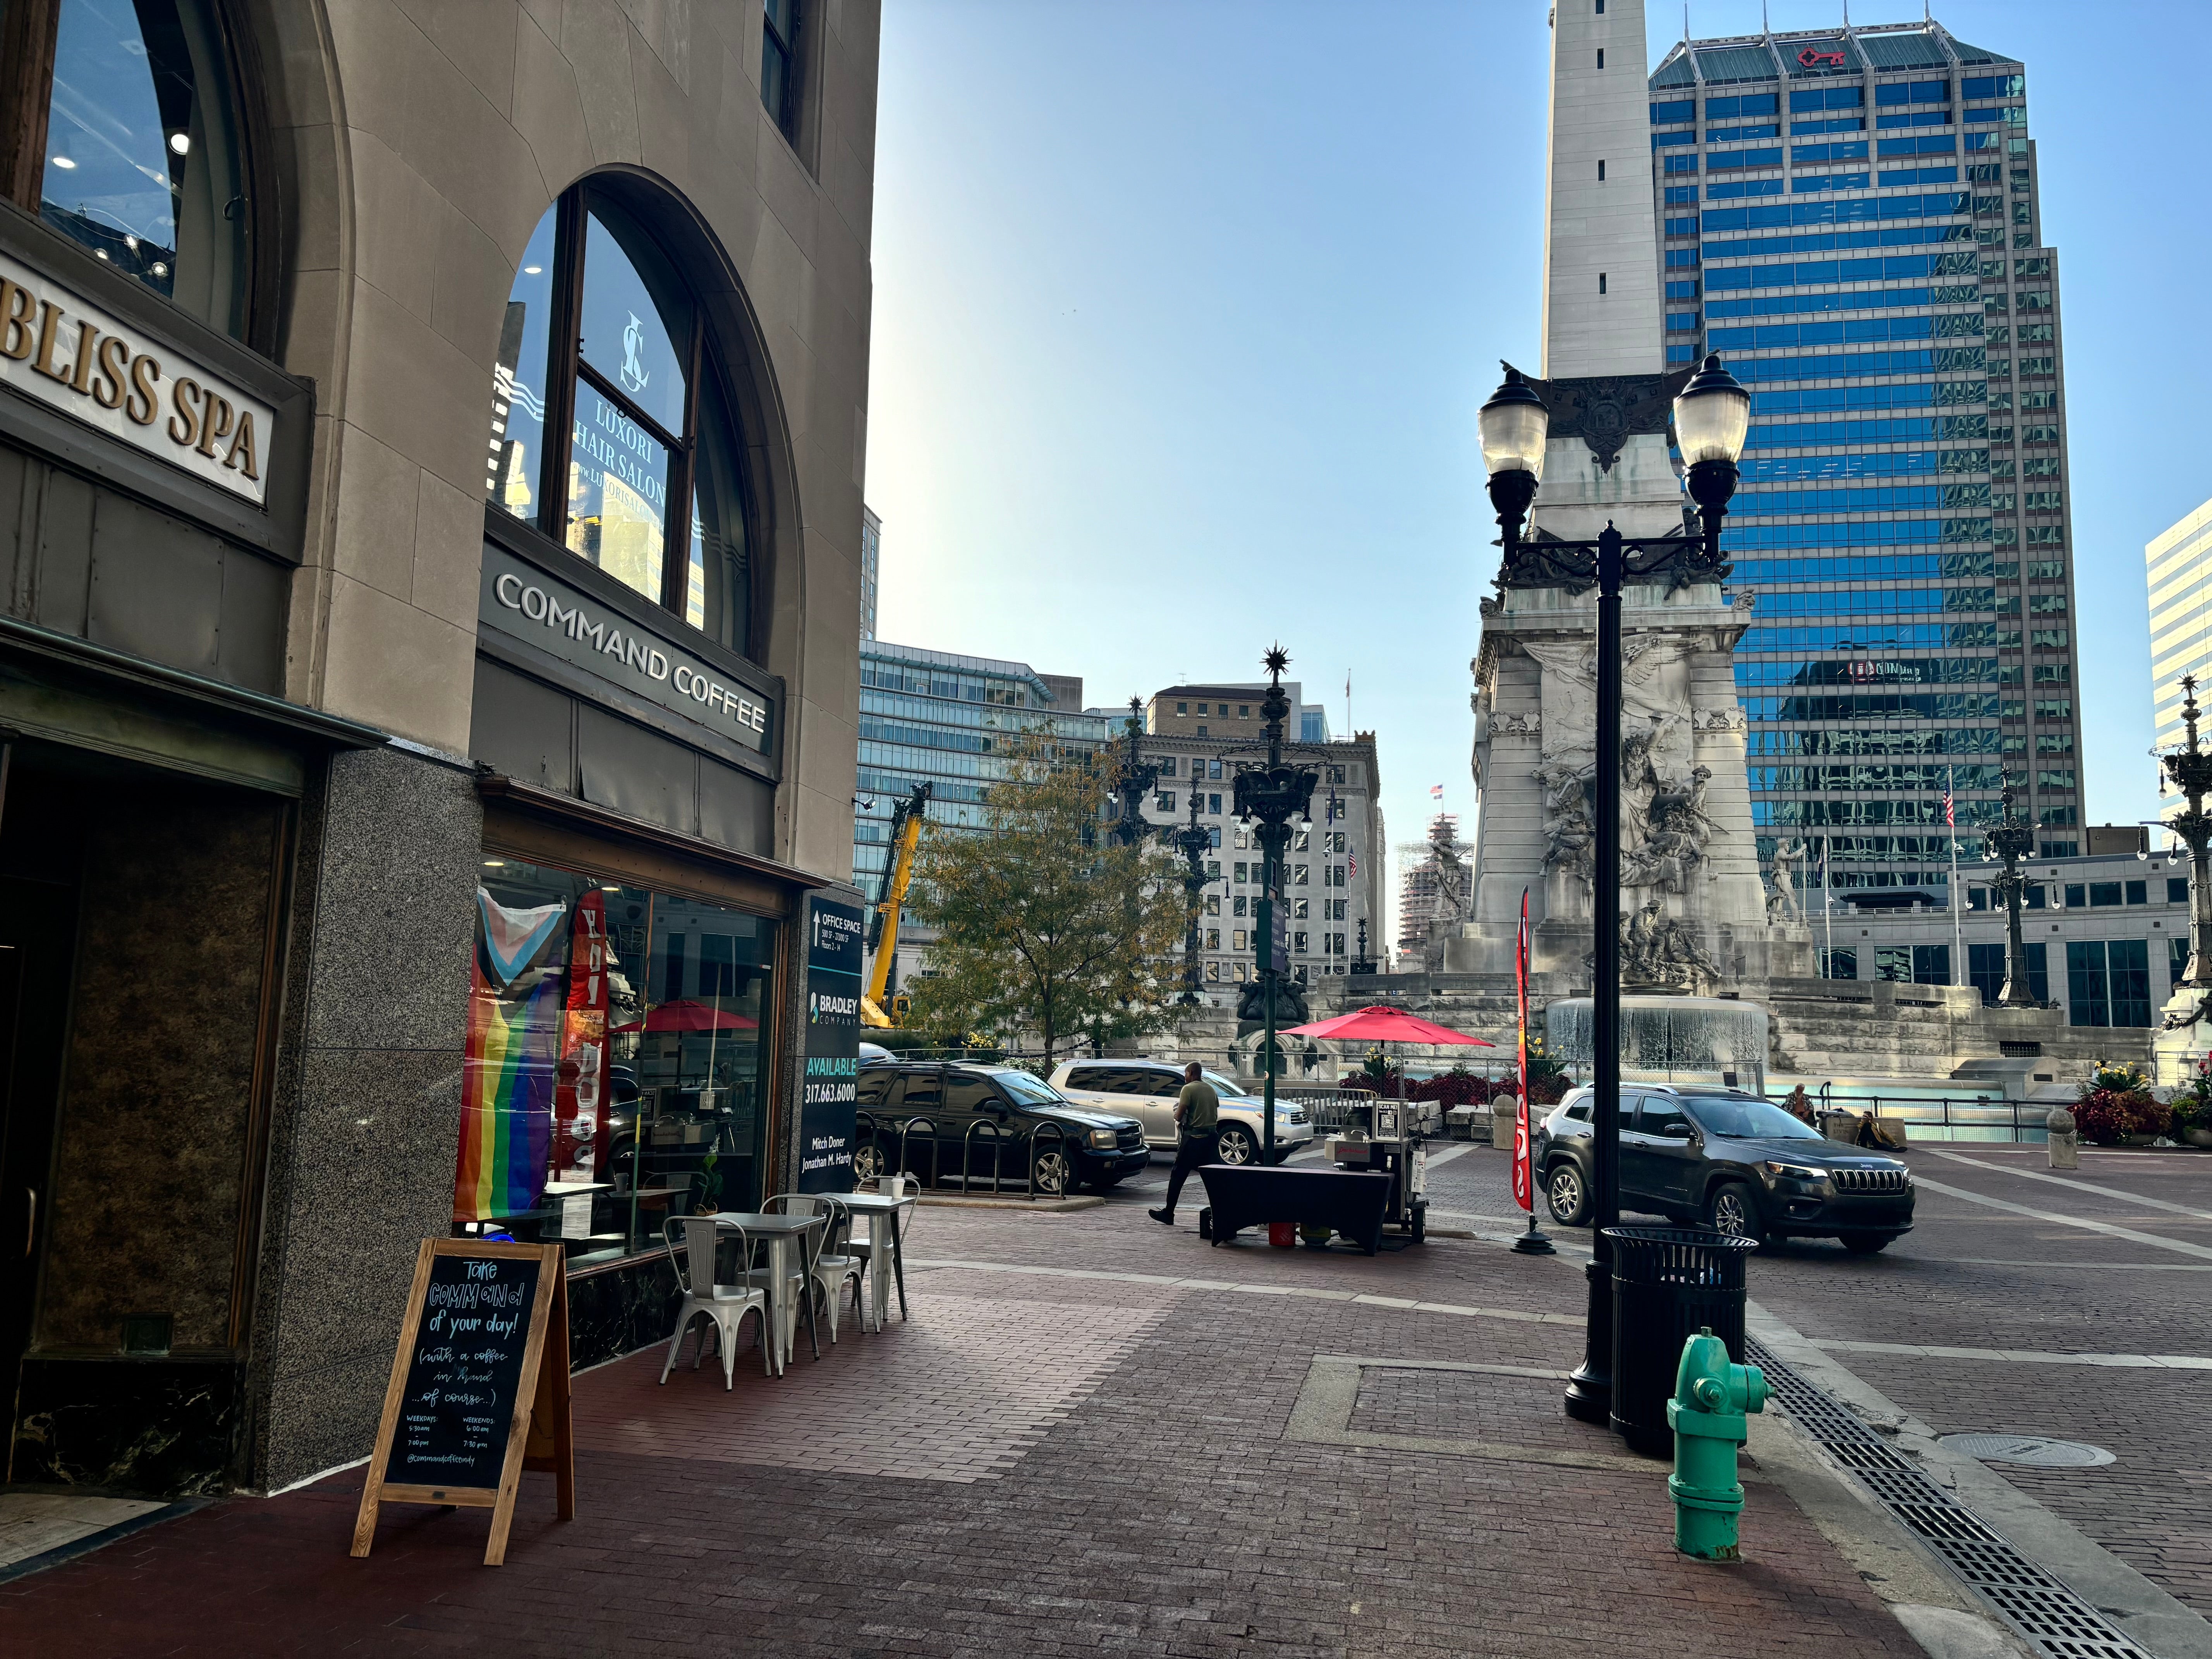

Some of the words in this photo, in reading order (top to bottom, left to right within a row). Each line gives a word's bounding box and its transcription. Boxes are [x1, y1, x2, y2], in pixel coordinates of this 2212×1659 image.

[0, 275, 161, 425] BLISS
[169, 377, 259, 481] SPA
[595, 399, 652, 464] LUXORI
[574, 419, 615, 471] HAIR
[618, 454, 666, 508] SALON
[496, 573, 668, 680] COMMAND
[673, 665, 766, 733] COFFEE
[823, 914, 843, 929] OFFICE
[843, 919, 860, 934] SPACE
[821, 940, 831, 950] Floors
[832, 942, 834, 950] 2
[828, 931, 833, 939] SF
[845, 934, 849, 943] SF
[820, 995, 857, 1015] BRADLEY
[820, 1015, 856, 1026] COMPANY
[806, 1058, 857, 1076] AVAILABLE
[805, 1084, 855, 1104] 317.663.6000
[812, 1137, 827, 1150] Mitch
[829, 1136, 845, 1148] Doner
[802, 1156, 826, 1173] Jonathan
[828, 1154, 834, 1166] M.
[836, 1151, 852, 1166] Hardy
[429, 1309, 446, 1331] of
[449, 1317, 481, 1339] your
[486, 1313, 519, 1340] day!
[420, 1347, 455, 1364] (with
[474, 1348, 508, 1363] coffee
[434, 1371, 452, 1382] in
[457, 1367, 493, 1384] hand
[407, 1415, 438, 1424] WEEKDAYS:
[407, 1454, 475, 1467] @commandcoffeeindy
